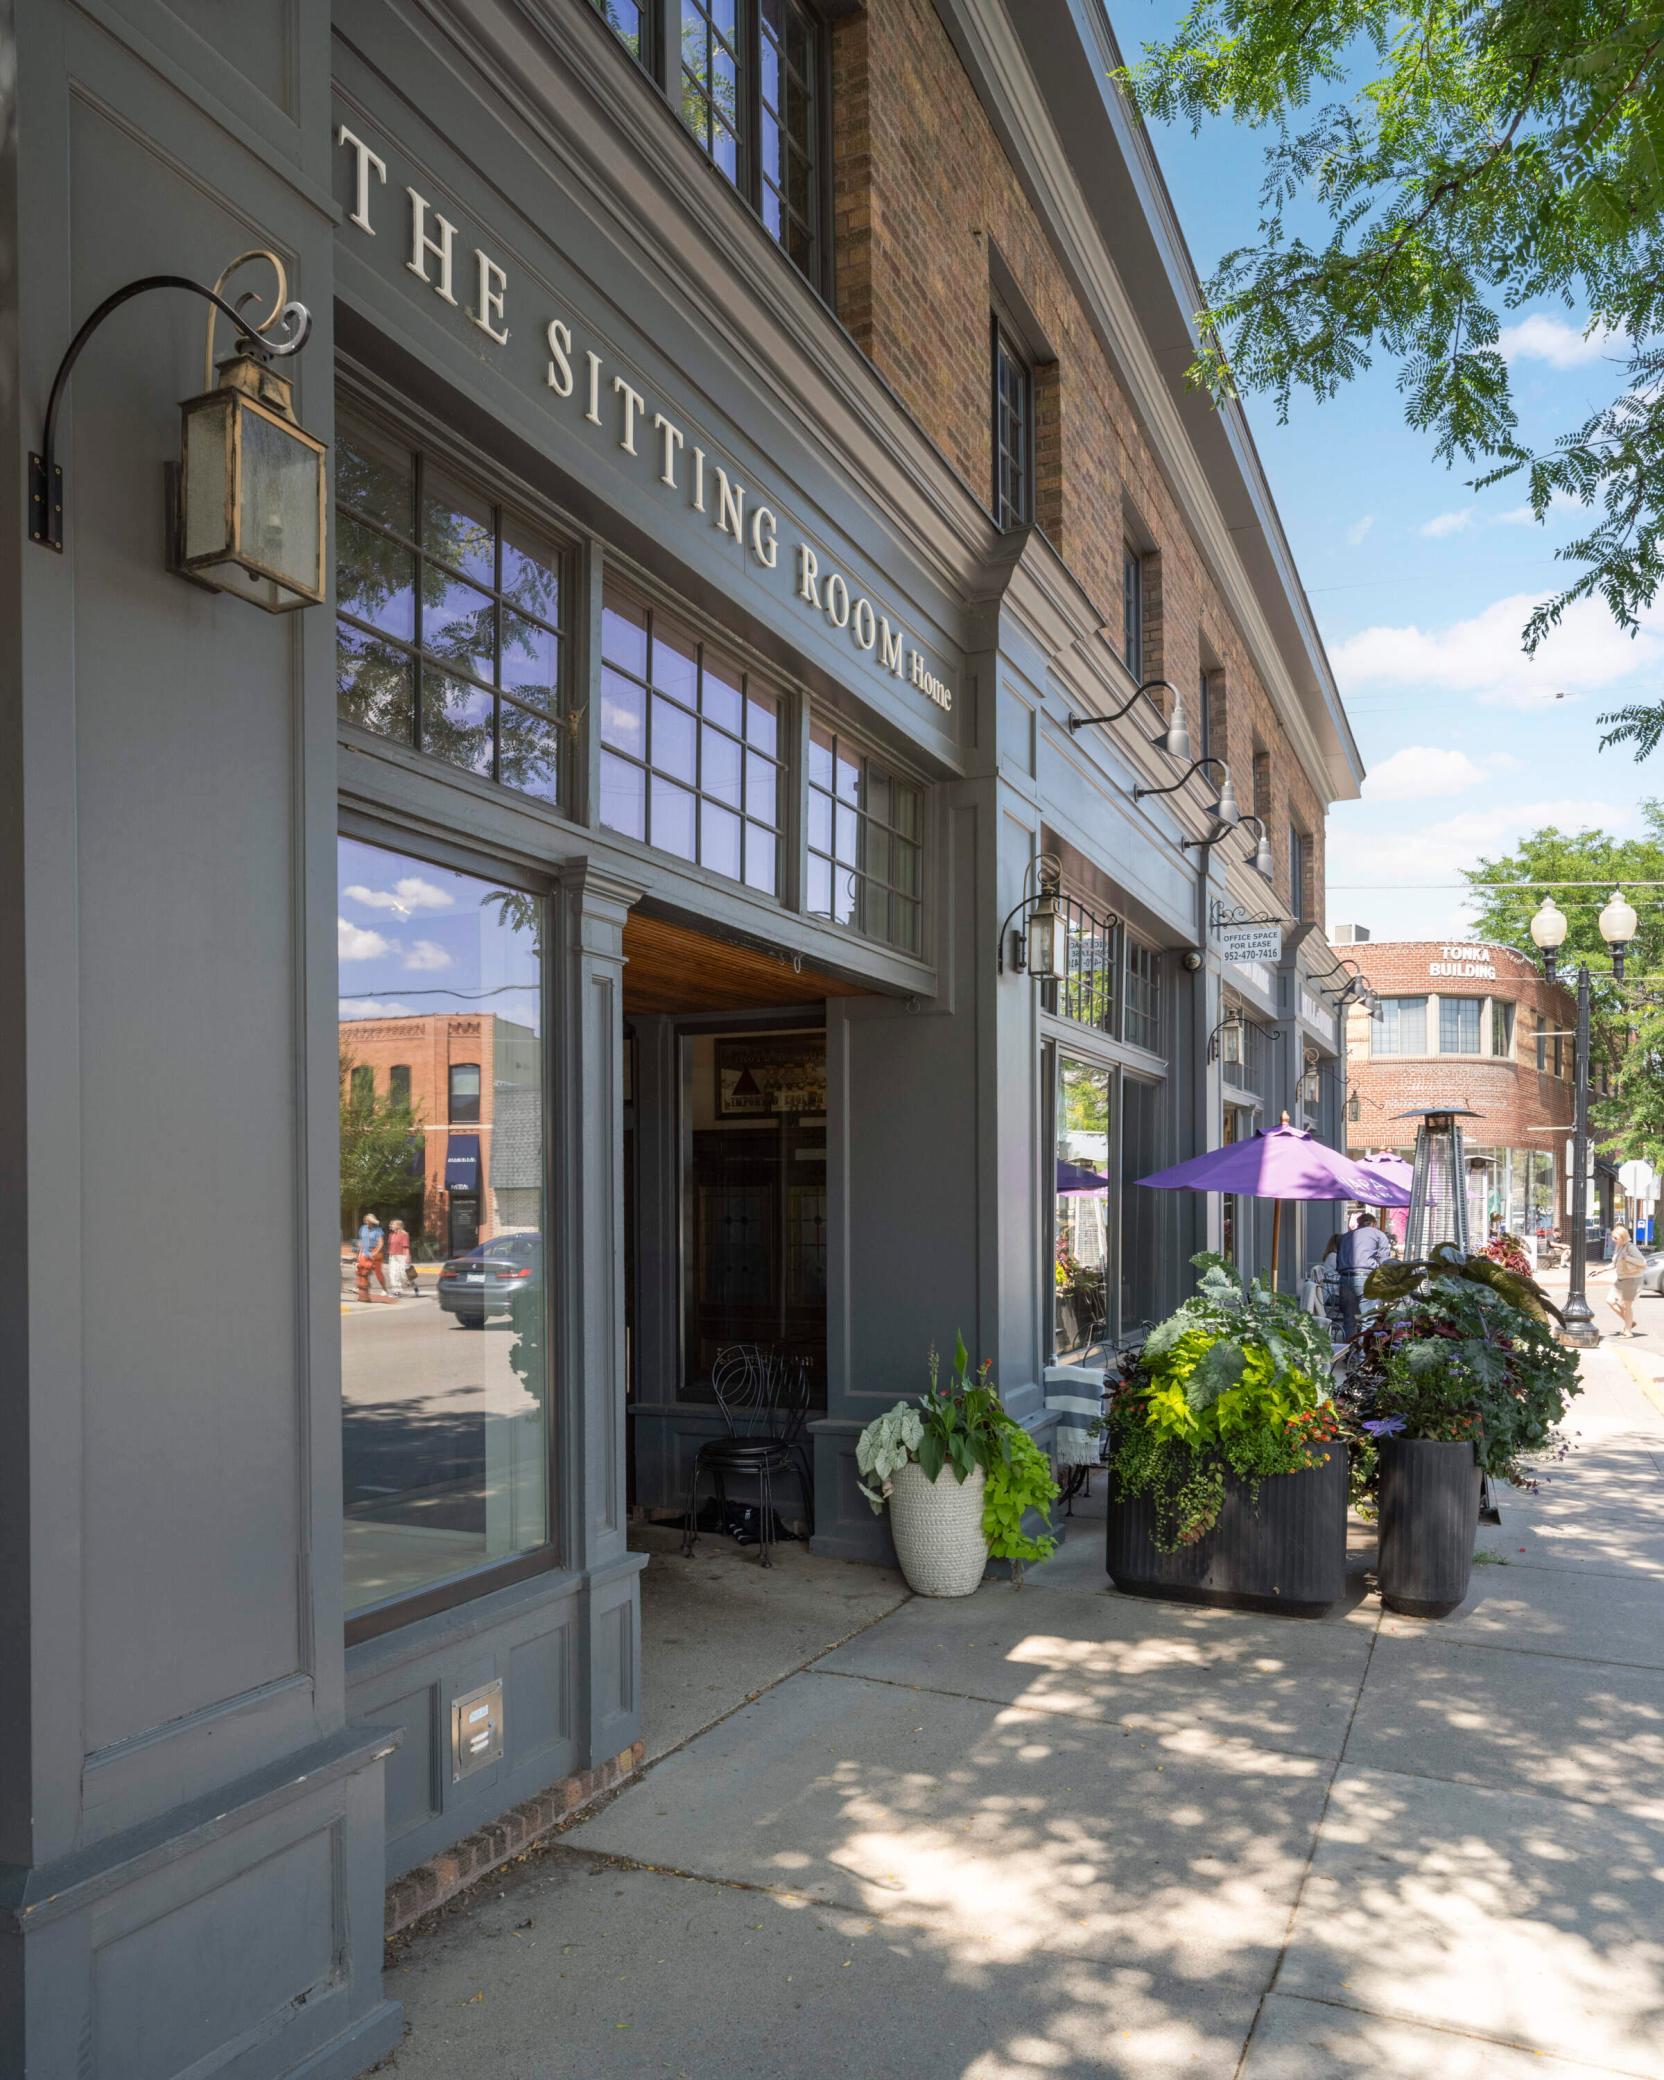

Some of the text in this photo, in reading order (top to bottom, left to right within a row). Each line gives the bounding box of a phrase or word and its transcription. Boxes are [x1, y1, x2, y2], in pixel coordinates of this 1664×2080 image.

[337, 124, 953, 712] THE SITTING ROOM Home
[1223, 931, 1278, 942] OFFICE SPACE
[1230, 940, 1271, 950] FOR LEASE
[1224, 948, 1278, 960] 952-470-7416
[1440, 946, 1490, 962] TONKA
[1429, 962, 1497, 980] BUILDING
